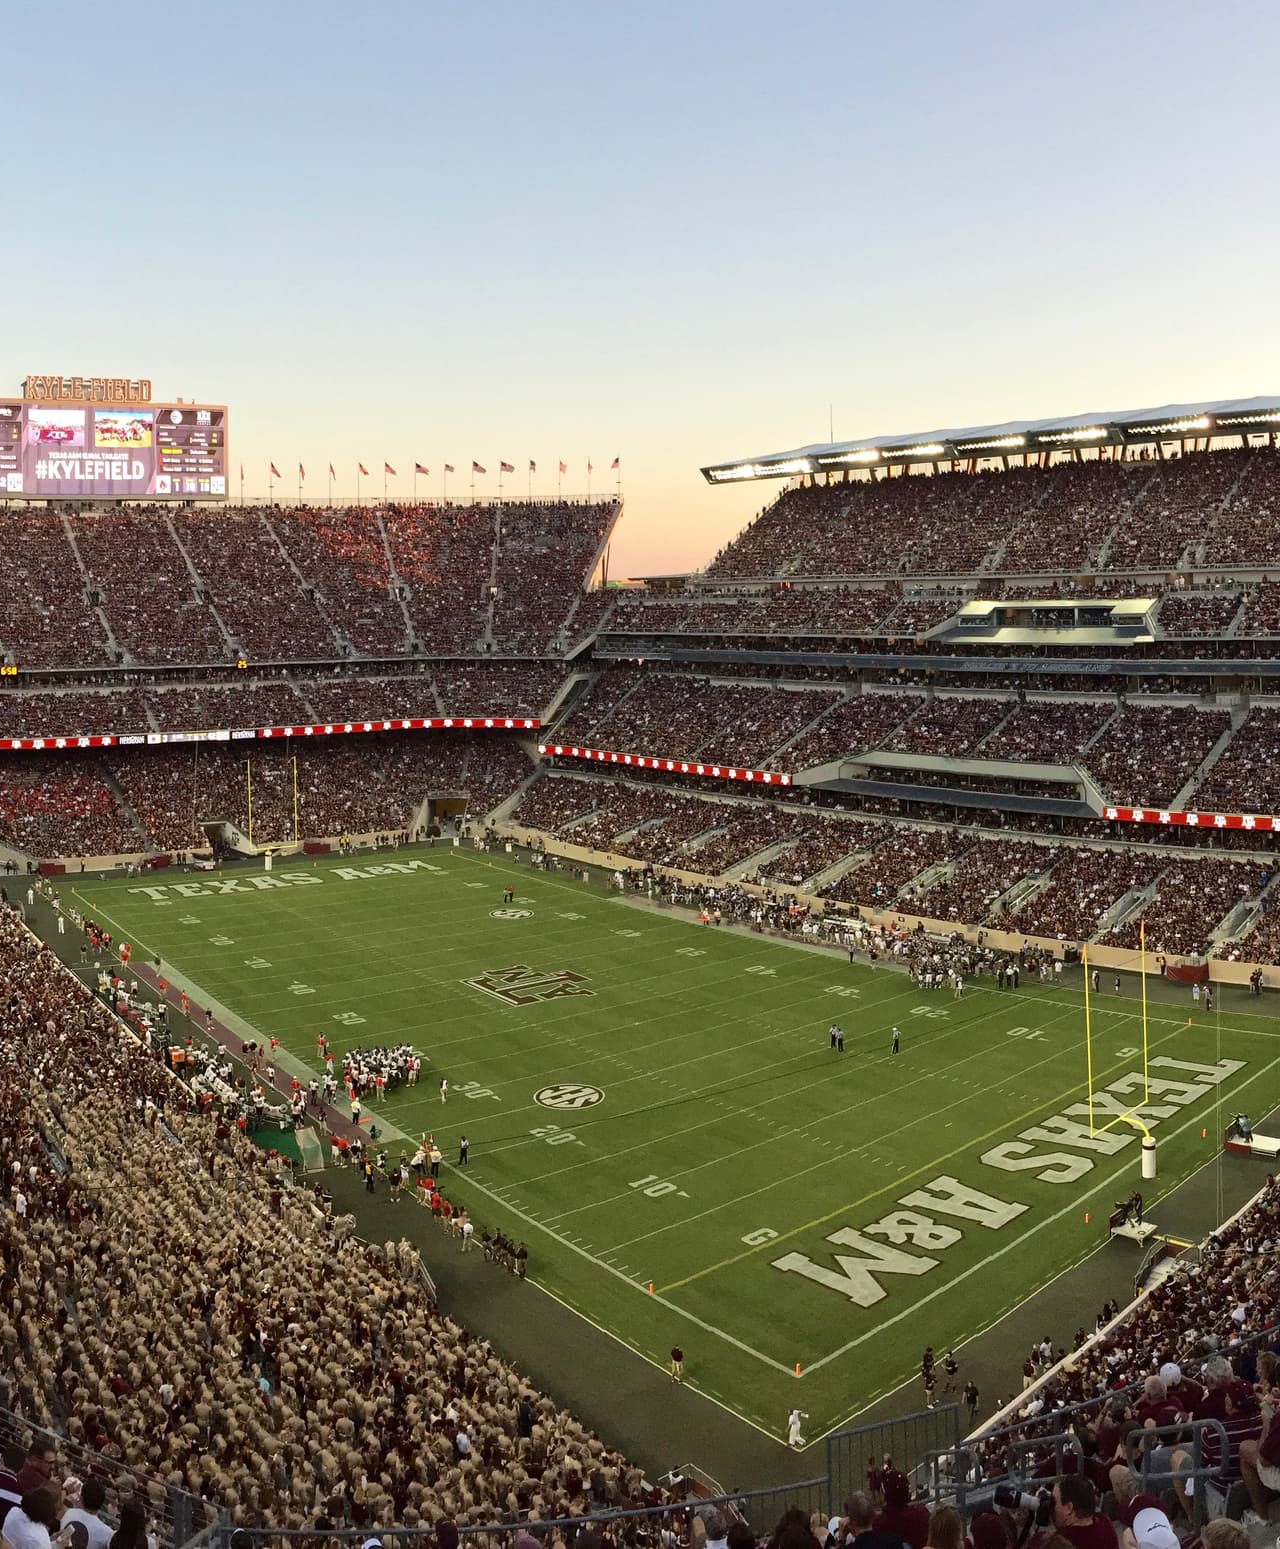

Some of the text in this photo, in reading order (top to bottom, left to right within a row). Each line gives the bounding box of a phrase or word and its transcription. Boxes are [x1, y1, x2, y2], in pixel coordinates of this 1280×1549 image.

[26, 376, 151, 402] KYLE FIELD
[35, 460, 145, 480] #KYLEFIELD
[127, 860, 442, 900] TEXAS A&M
[332, 1012, 367, 1025] 50
[453, 1081, 495, 1100] 30
[529, 1125, 577, 1145] 20
[628, 1175, 677, 1197] 10
[771, 1056, 1248, 1309] TEXAS A&M
[741, 1228, 778, 1246] G
